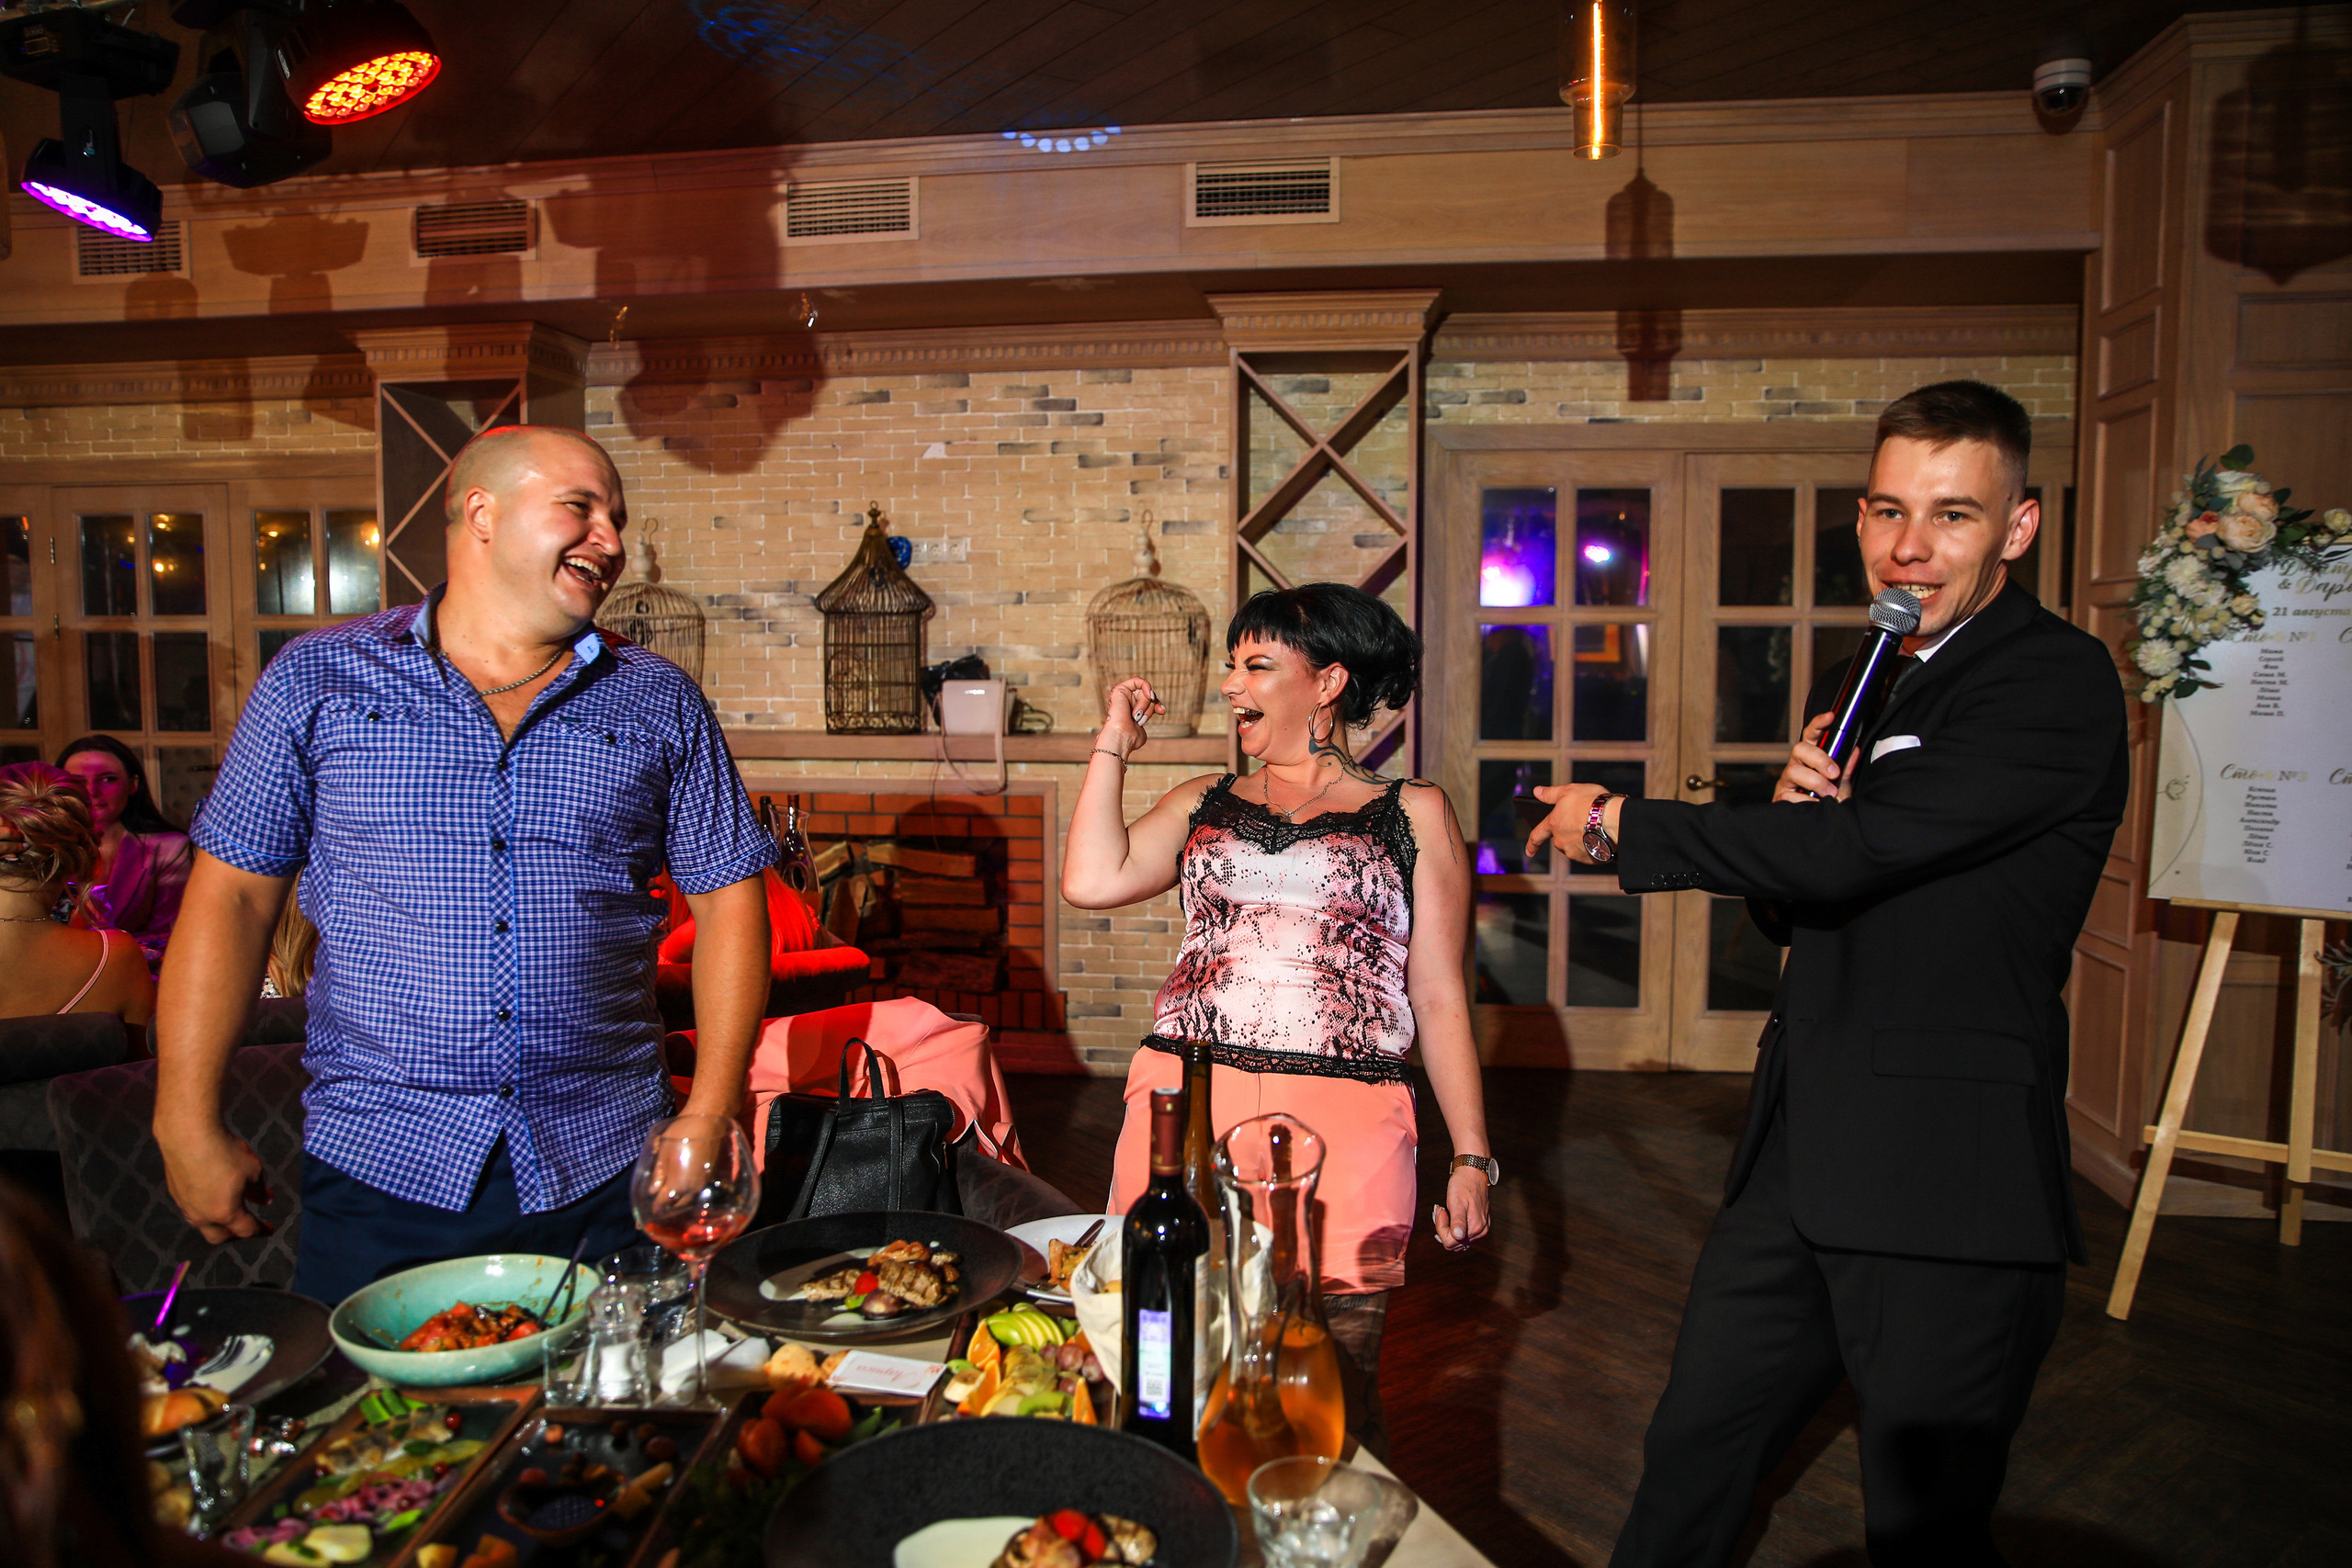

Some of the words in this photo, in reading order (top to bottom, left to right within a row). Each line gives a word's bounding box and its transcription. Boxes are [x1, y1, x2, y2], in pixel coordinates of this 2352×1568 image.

[2278, 578, 2292, 590] &
[2272, 607, 2288, 616] 21
[2292, 608, 2351, 618] августа
[2220, 763, 2275, 781] Стол
